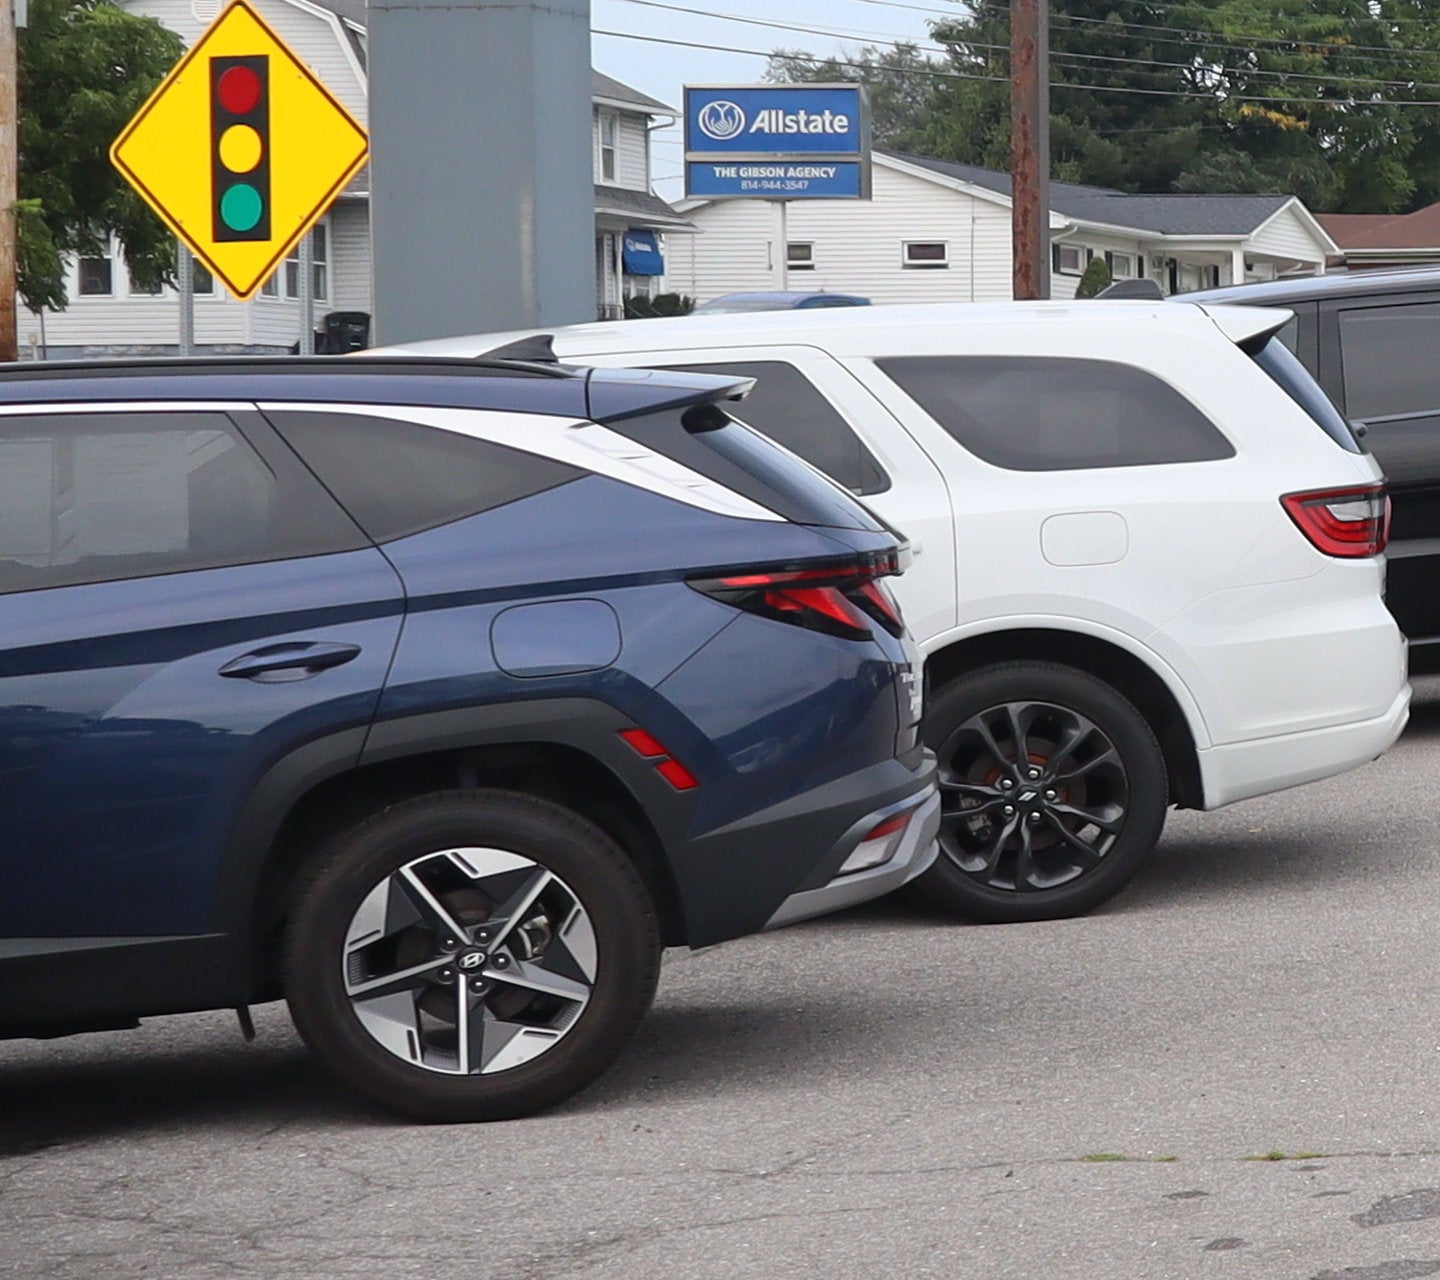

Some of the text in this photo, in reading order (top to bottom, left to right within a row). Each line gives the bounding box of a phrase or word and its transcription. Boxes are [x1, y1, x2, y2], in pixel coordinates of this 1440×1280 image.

[749, 109, 849, 134] Allstate
[713, 166, 836, 179] THE GIBSON AGENCY
